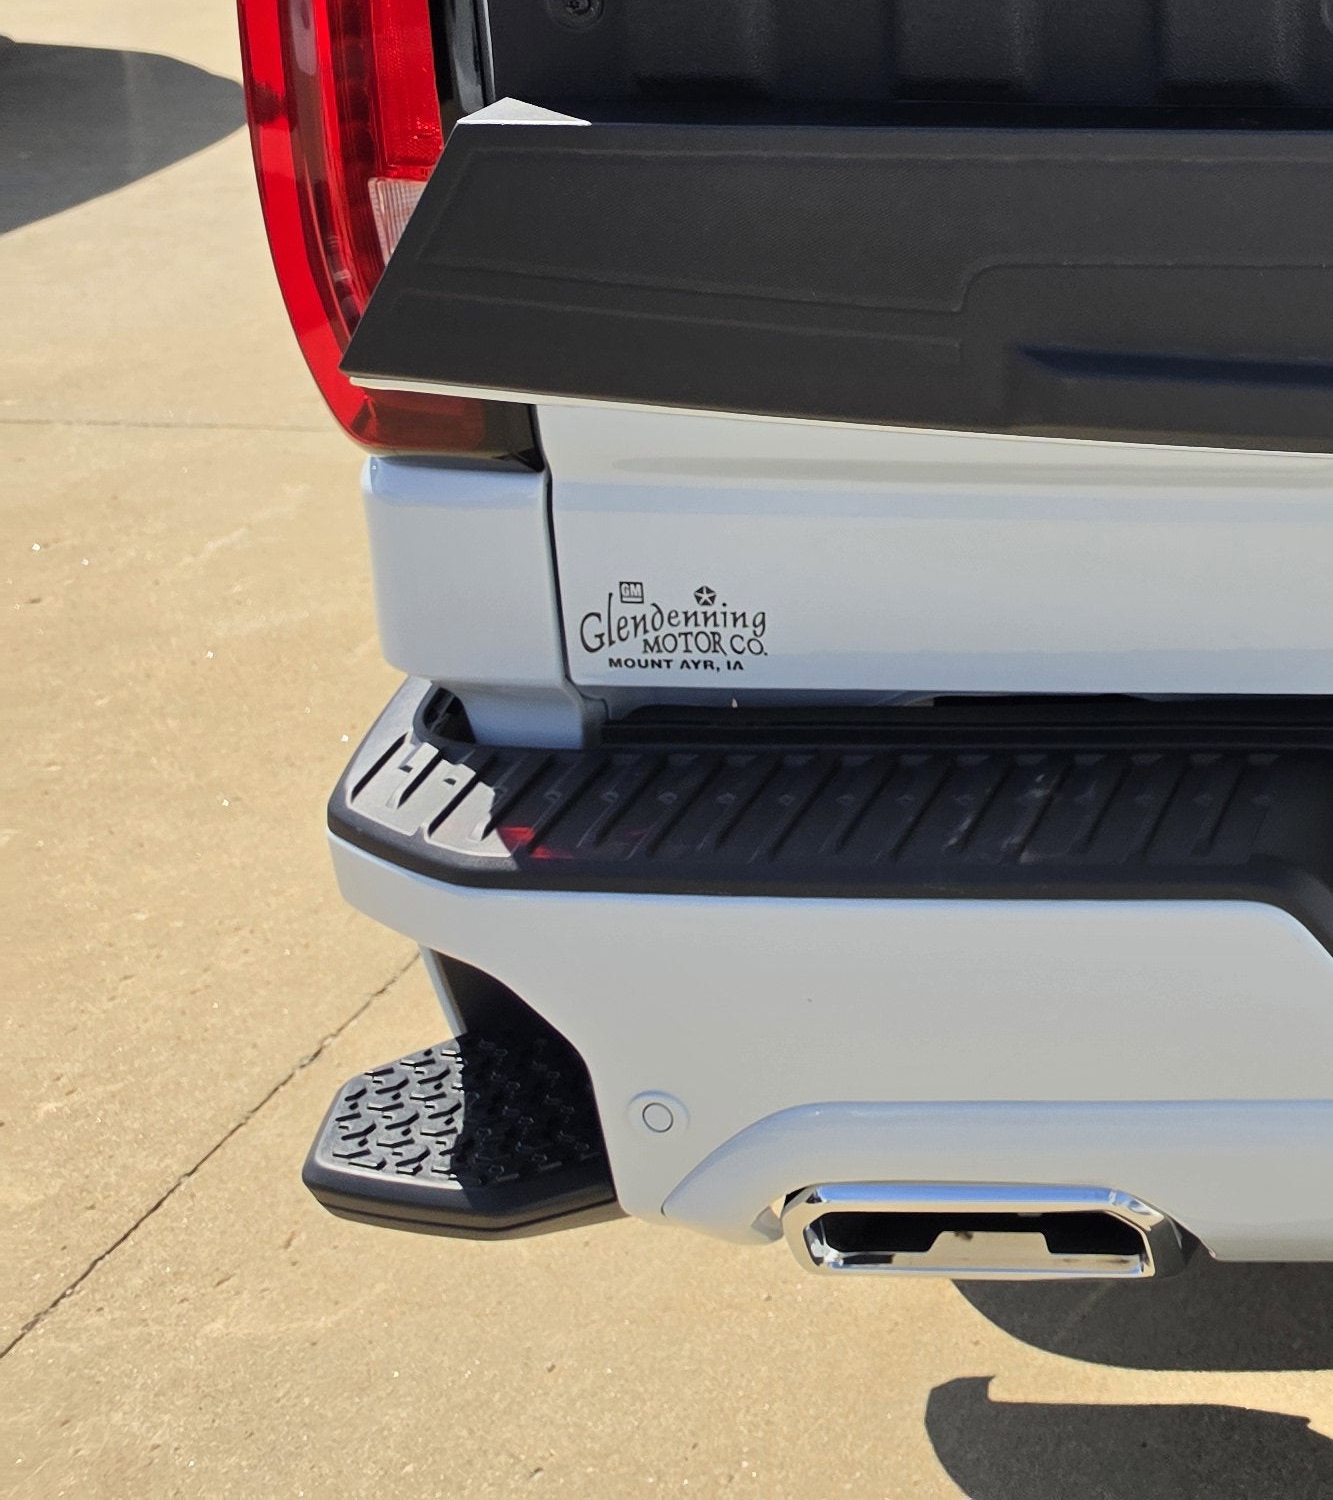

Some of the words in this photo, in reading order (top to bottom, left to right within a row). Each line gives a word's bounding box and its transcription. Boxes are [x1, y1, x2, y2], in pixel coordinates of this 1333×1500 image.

[620, 583, 643, 597] GM
[580, 592, 766, 653] Glendenning
[642, 631, 727, 656] MOTOR
[730, 635, 768, 656] CO.
[608, 658, 673, 669] MOUNT
[680, 660, 720, 672] AYR,
[727, 661, 744, 670] IA
